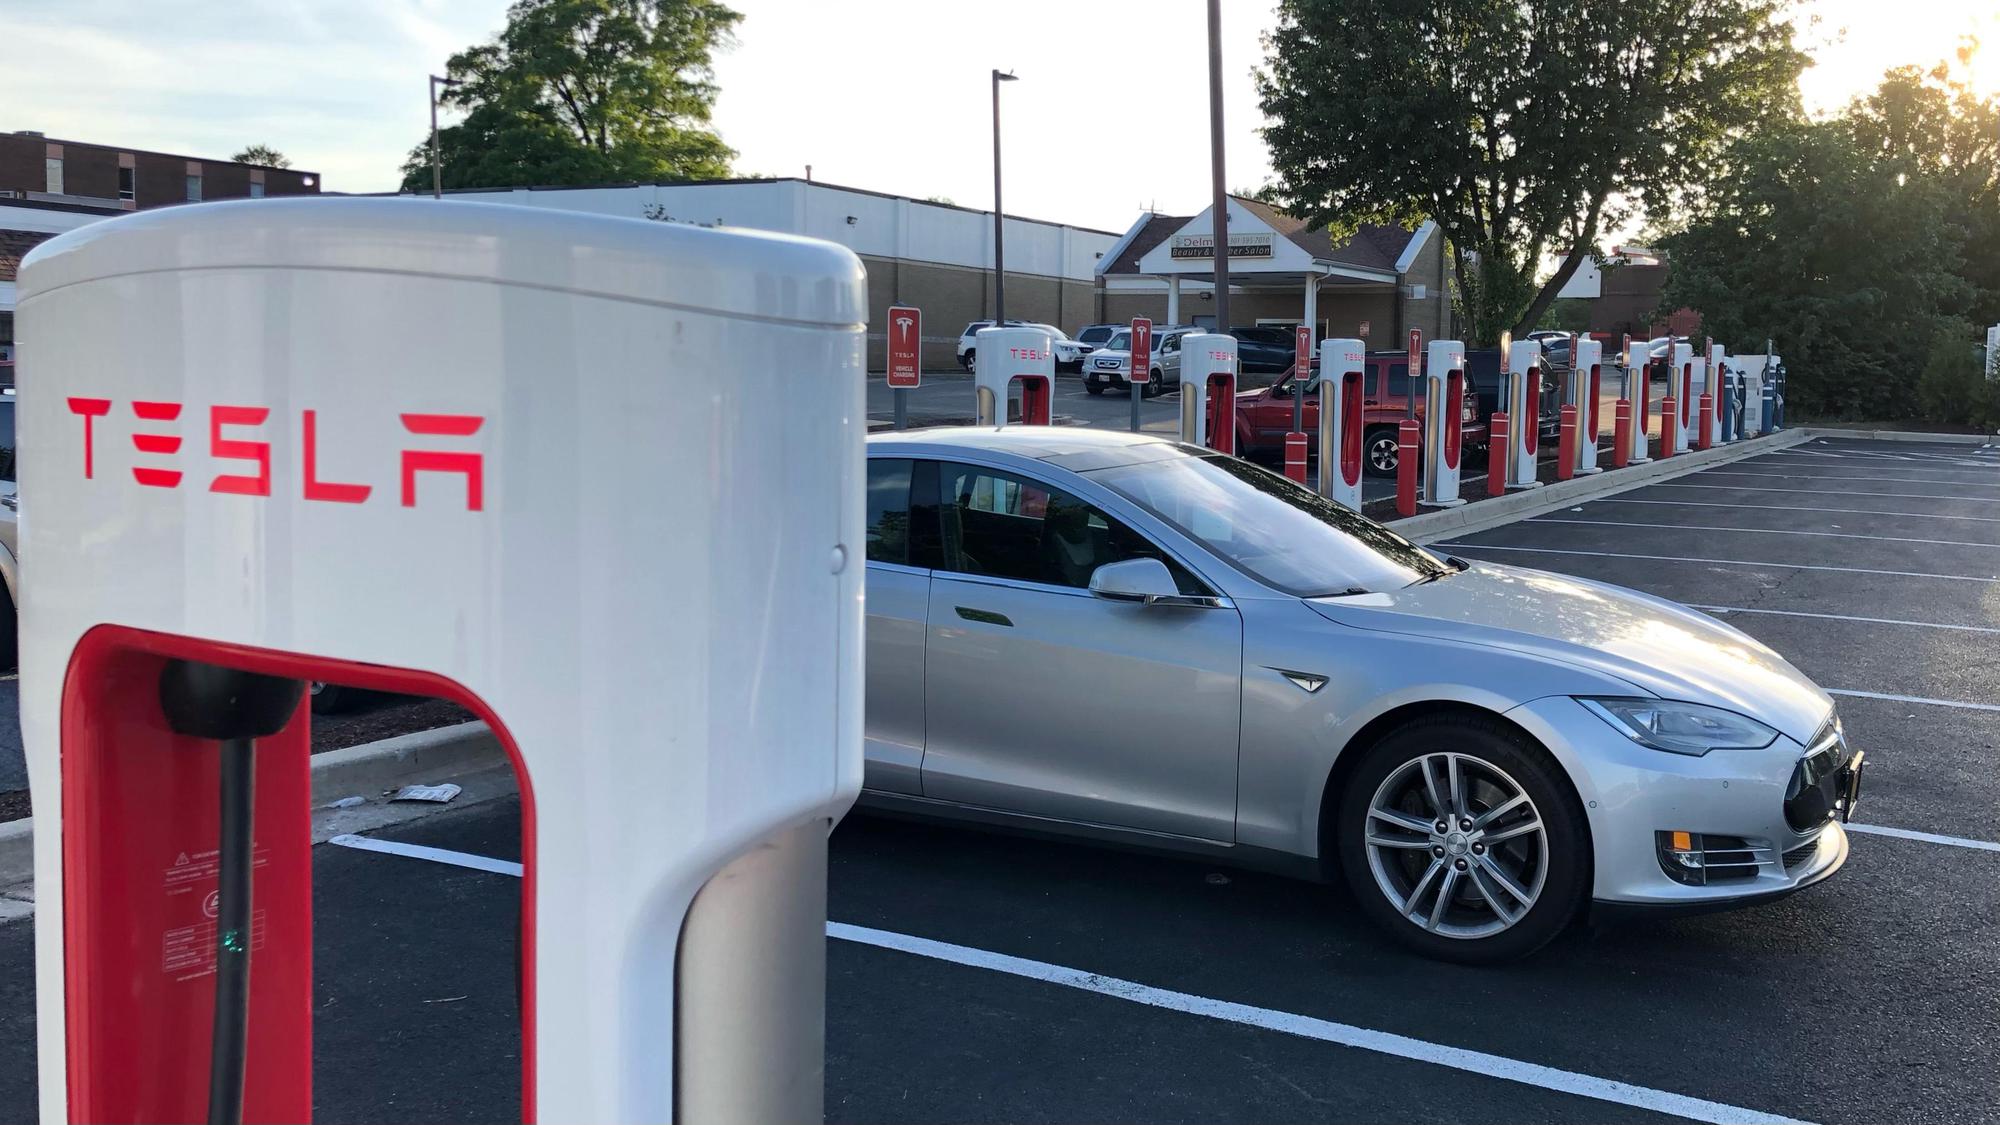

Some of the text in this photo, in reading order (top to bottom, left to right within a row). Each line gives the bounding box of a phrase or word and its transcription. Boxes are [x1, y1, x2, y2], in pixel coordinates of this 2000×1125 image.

[1172, 247, 1202, 257] Beauty
[1203, 247, 1210, 256] &
[1244, 245, 1270, 255] Salon
[66, 396, 486, 512] TESLA
